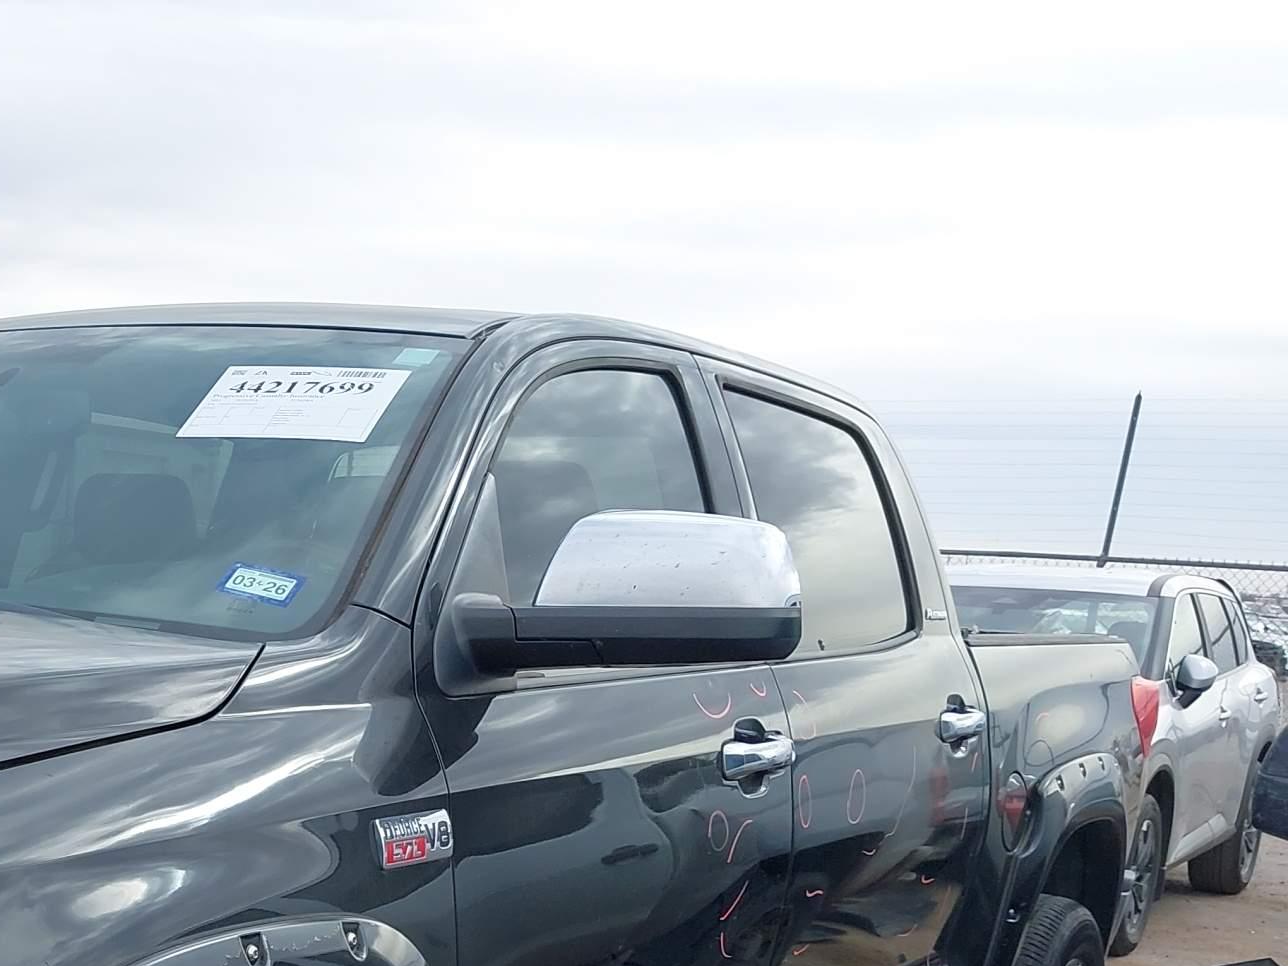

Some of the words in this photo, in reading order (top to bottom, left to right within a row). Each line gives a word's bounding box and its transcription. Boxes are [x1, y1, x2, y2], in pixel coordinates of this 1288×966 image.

[229, 380, 375, 395] 44217699
[232, 574, 256, 588] 03
[262, 581, 288, 595] 26
[424, 820, 451, 851] V8
